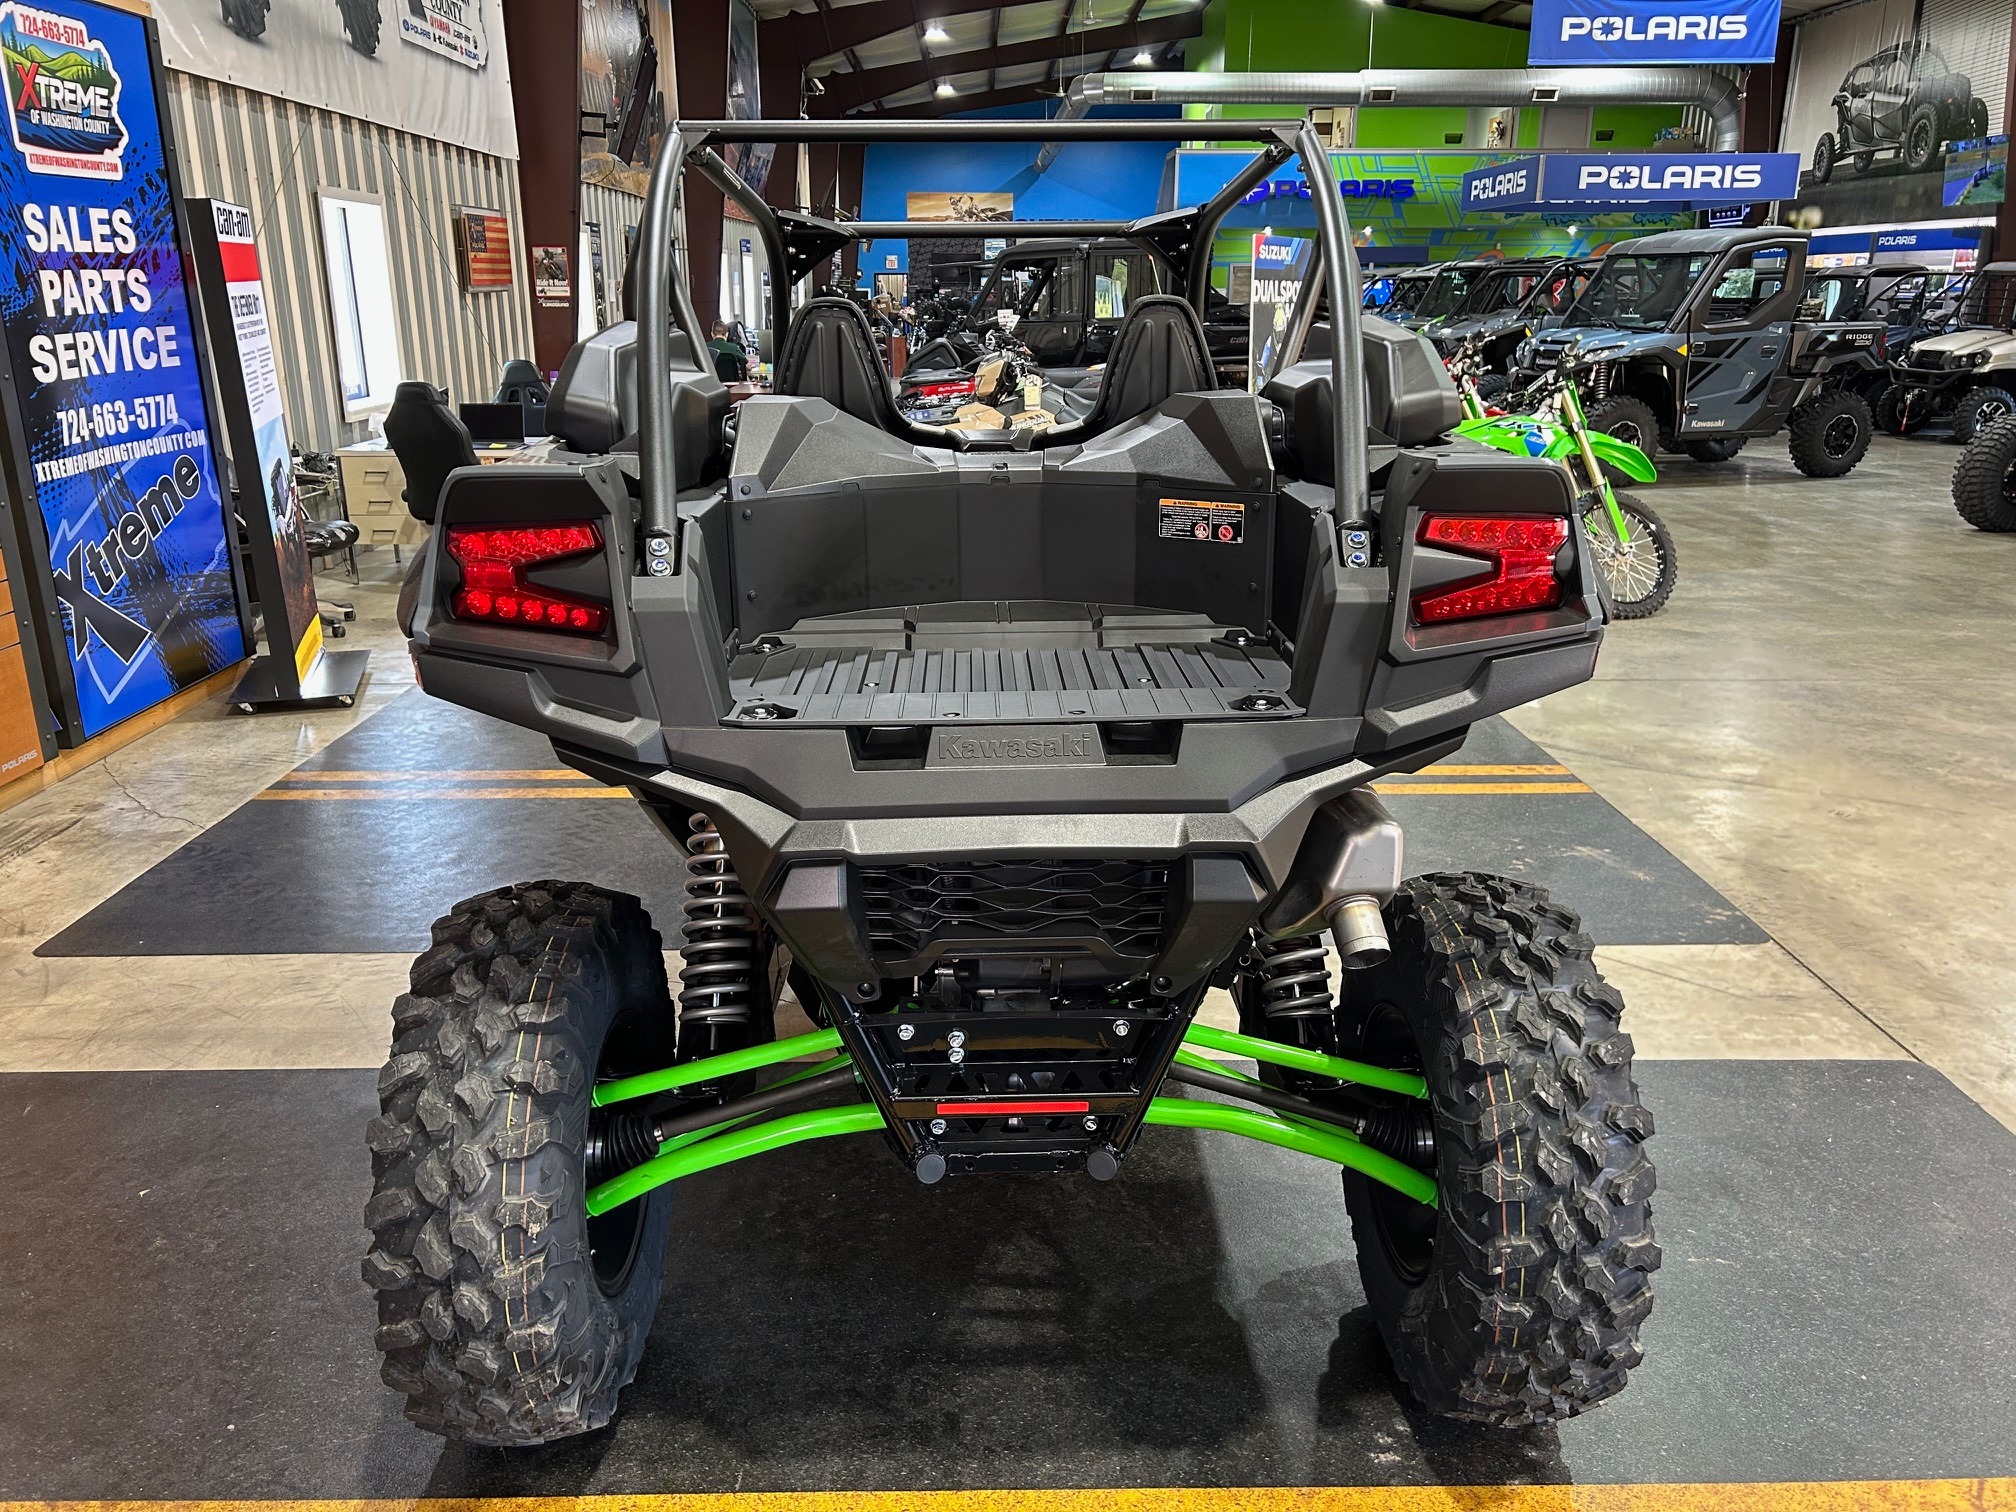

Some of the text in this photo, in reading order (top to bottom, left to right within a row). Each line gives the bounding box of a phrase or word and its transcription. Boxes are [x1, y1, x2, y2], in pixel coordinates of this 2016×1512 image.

[20, 13, 86, 47] 724-663-5774
[1560, 15, 1748, 42] POLARIS
[15, 62, 110, 118] XTREME
[30, 109, 110, 134] OF WASHINGTON COUNTY
[1470, 169, 1527, 201] POLARIS
[1579, 164, 1762, 189] POLARIS
[22, 203, 136, 254] SALES
[216, 206, 251, 238] can-am
[1259, 245, 1292, 260] SUZUKI
[1878, 235, 1917, 246] POLARIS
[39, 269, 152, 318] PARTS
[1253, 279, 1302, 303] DUALSPO
[1845, 333, 1874, 341] RIDGE
[29, 326, 181, 384] SERVICE
[56, 393, 179, 447] 724-663-5774
[1691, 419, 1725, 428] Kawasaki
[53, 454, 201, 666] Xtreme
[938, 732, 1090, 760] Kawasaki
[2, 749, 38, 773] POLARIS
